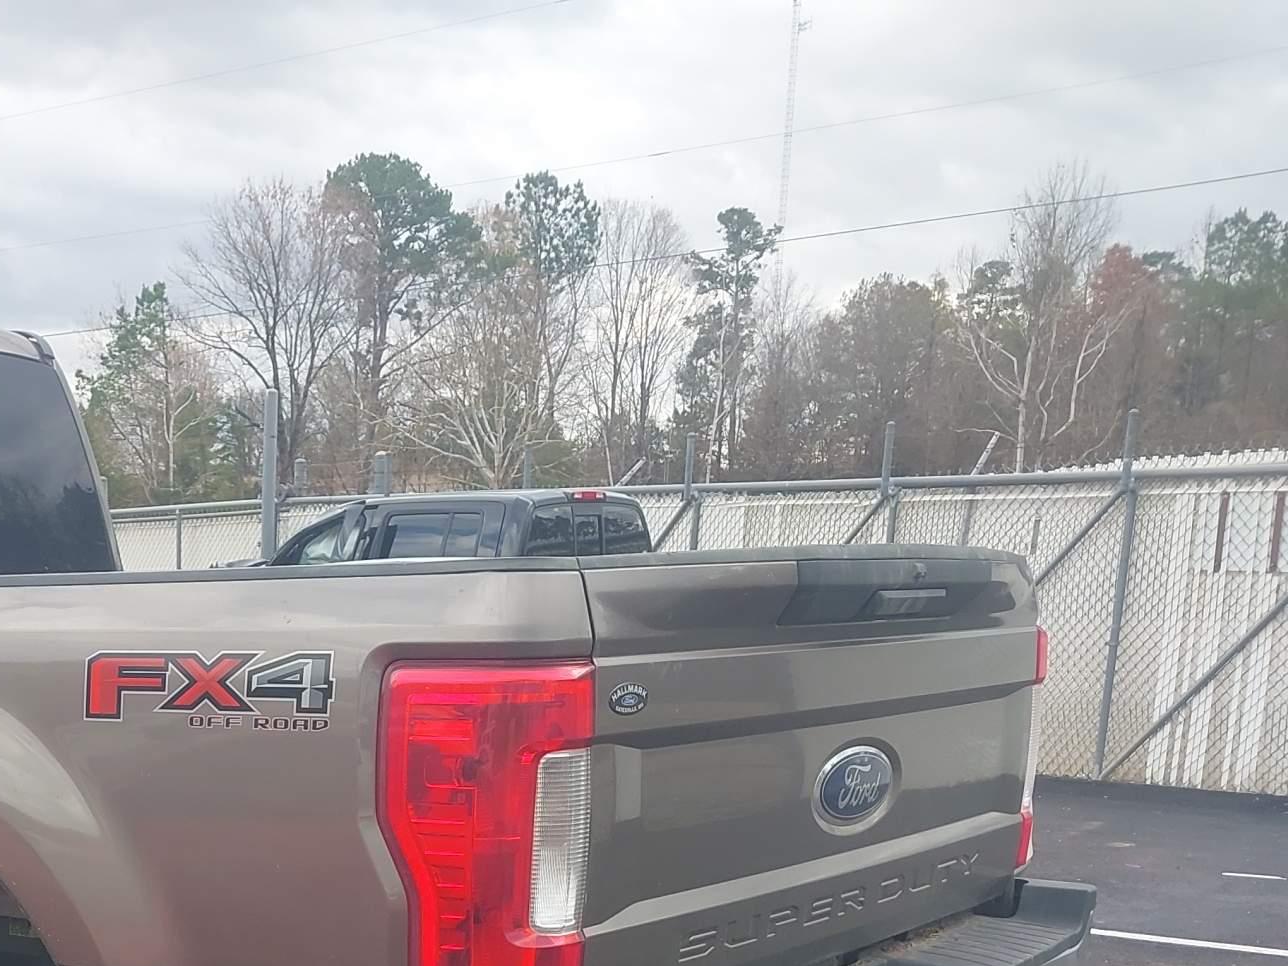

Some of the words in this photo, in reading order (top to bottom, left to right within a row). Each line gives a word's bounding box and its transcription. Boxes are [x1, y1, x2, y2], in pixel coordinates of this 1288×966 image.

[84, 650, 335, 721] FX4
[611, 683, 648, 703] HALLMARK
[187, 715, 243, 730] OFF
[252, 717, 330, 732] ROAD
[838, 763, 882, 810] Ford
[678, 886, 867, 963] SUPER
[877, 853, 980, 904] DUTY
